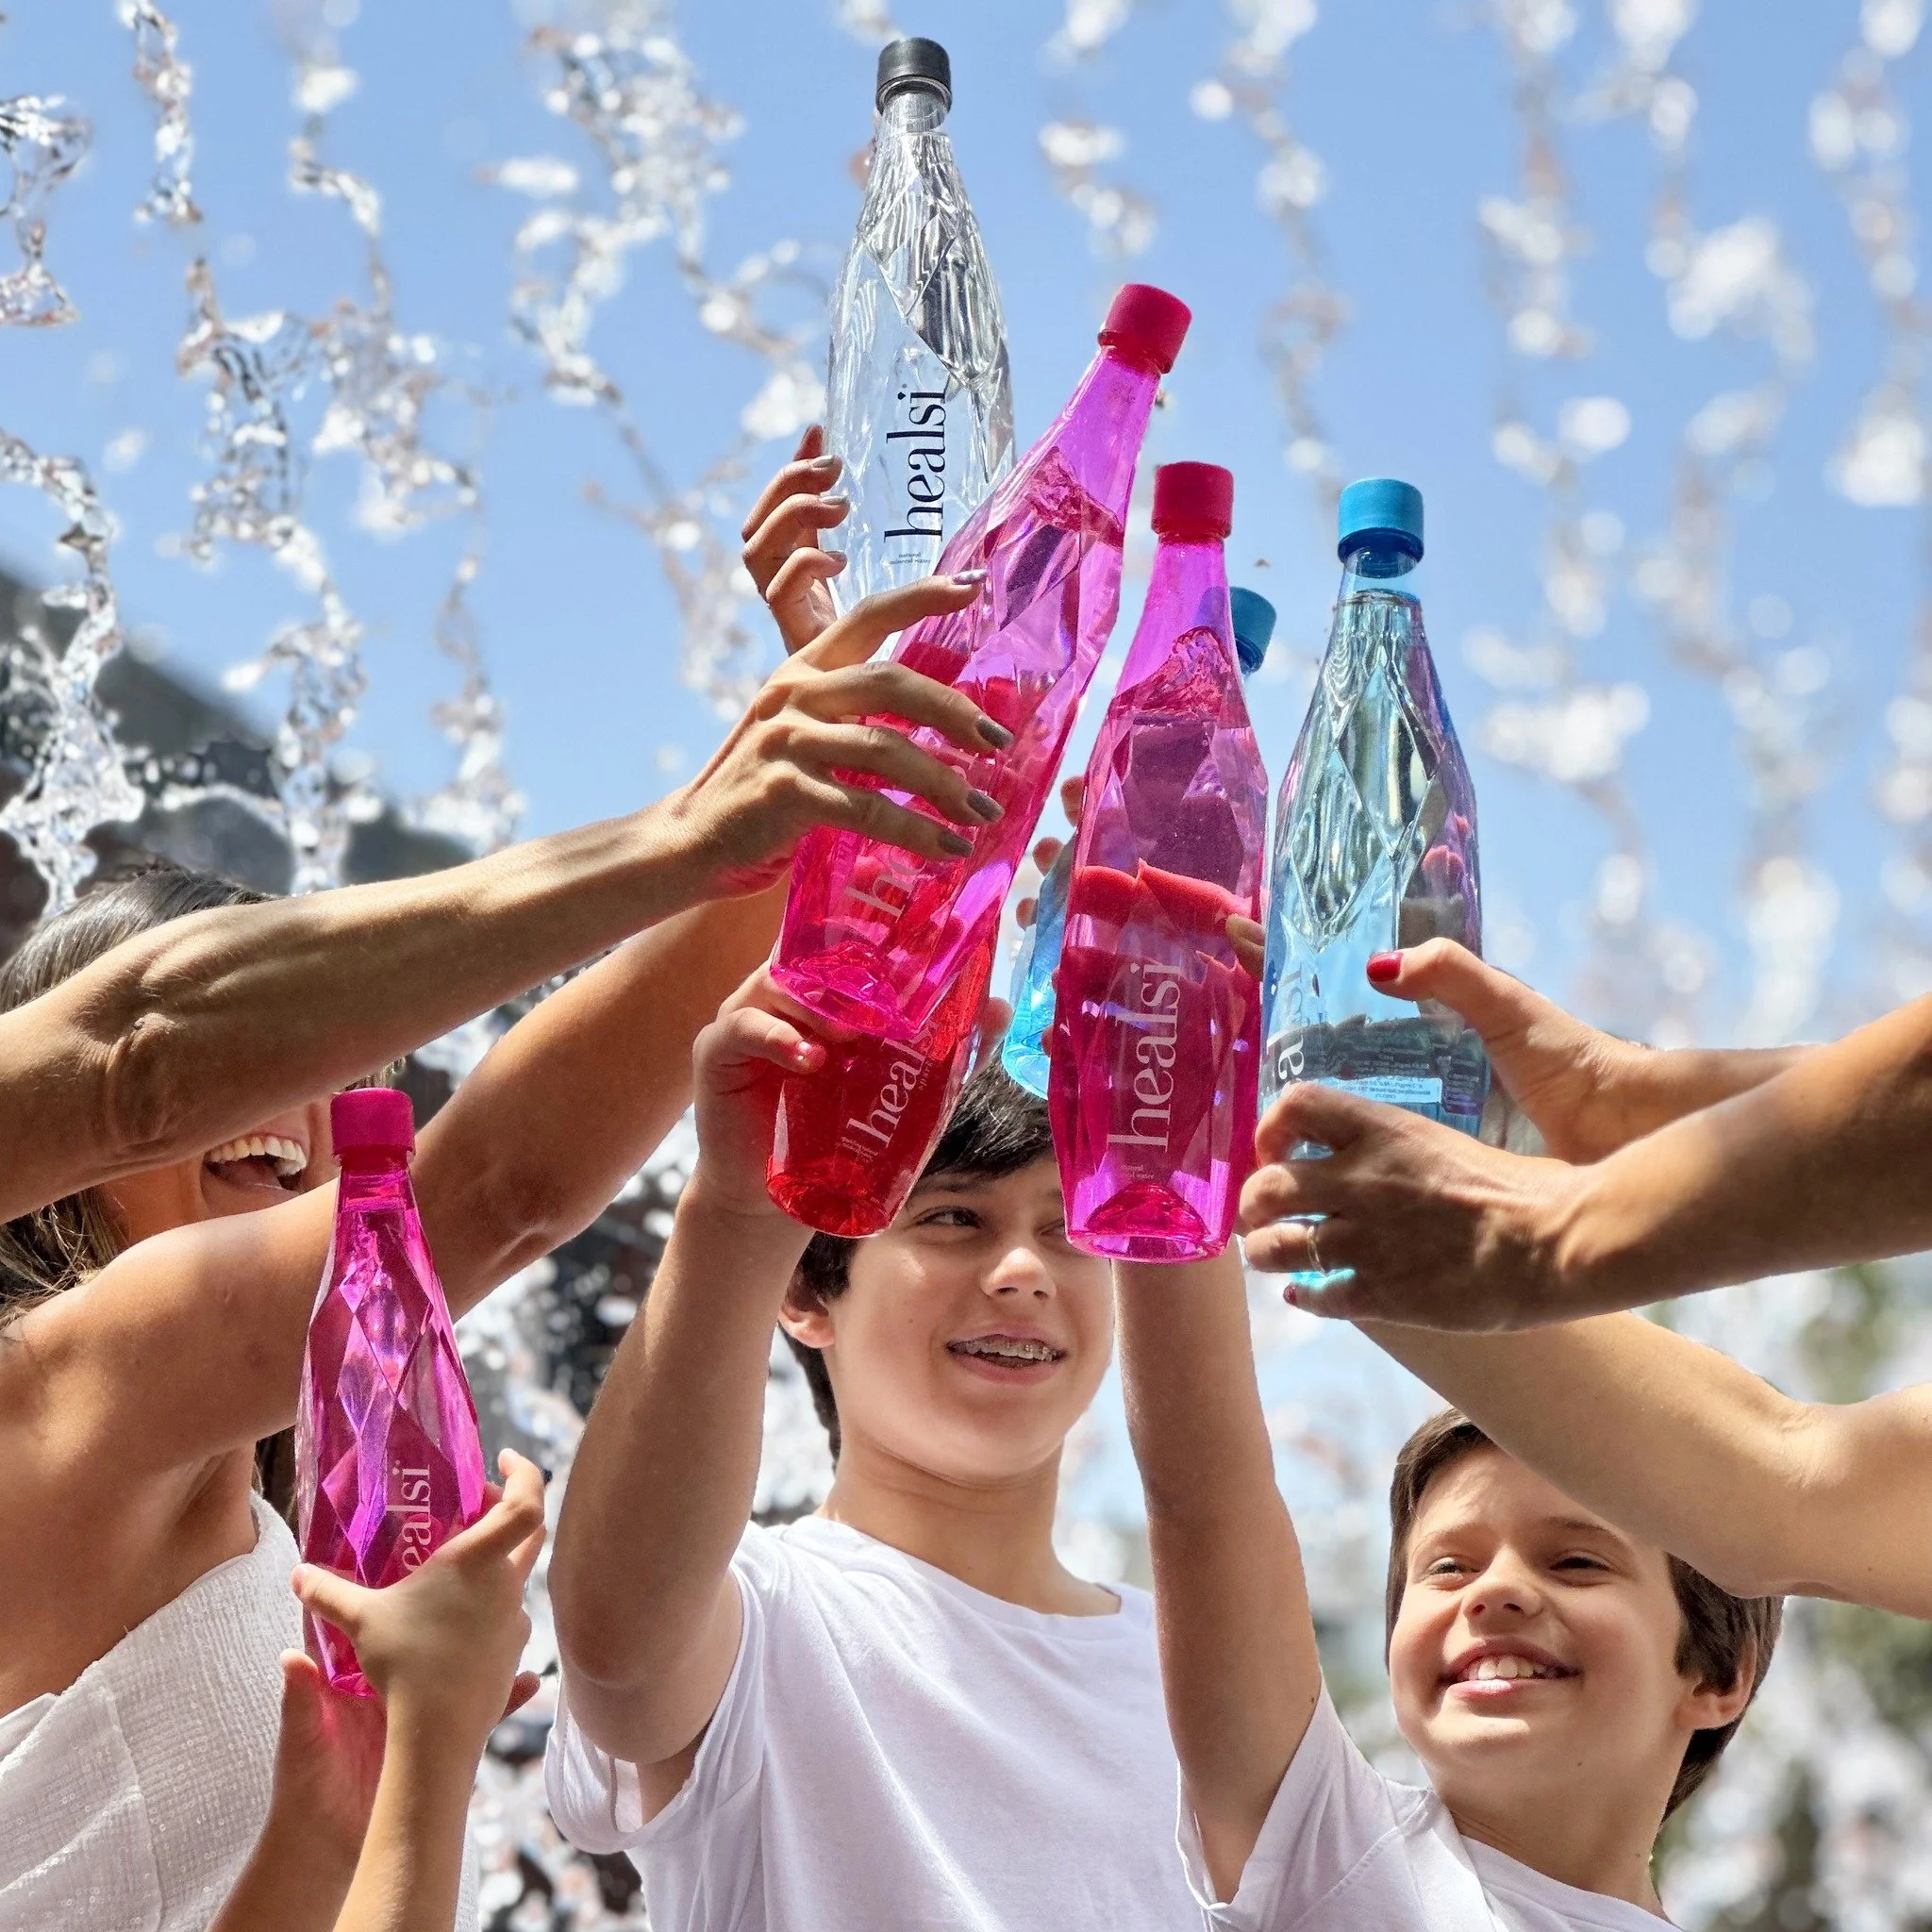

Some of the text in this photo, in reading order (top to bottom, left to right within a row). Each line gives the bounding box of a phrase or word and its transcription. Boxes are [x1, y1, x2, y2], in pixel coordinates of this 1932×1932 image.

[883, 386, 946, 543] healsi
[1107, 962, 1181, 1154] healsi
[386, 1462, 431, 1573] ealsi
